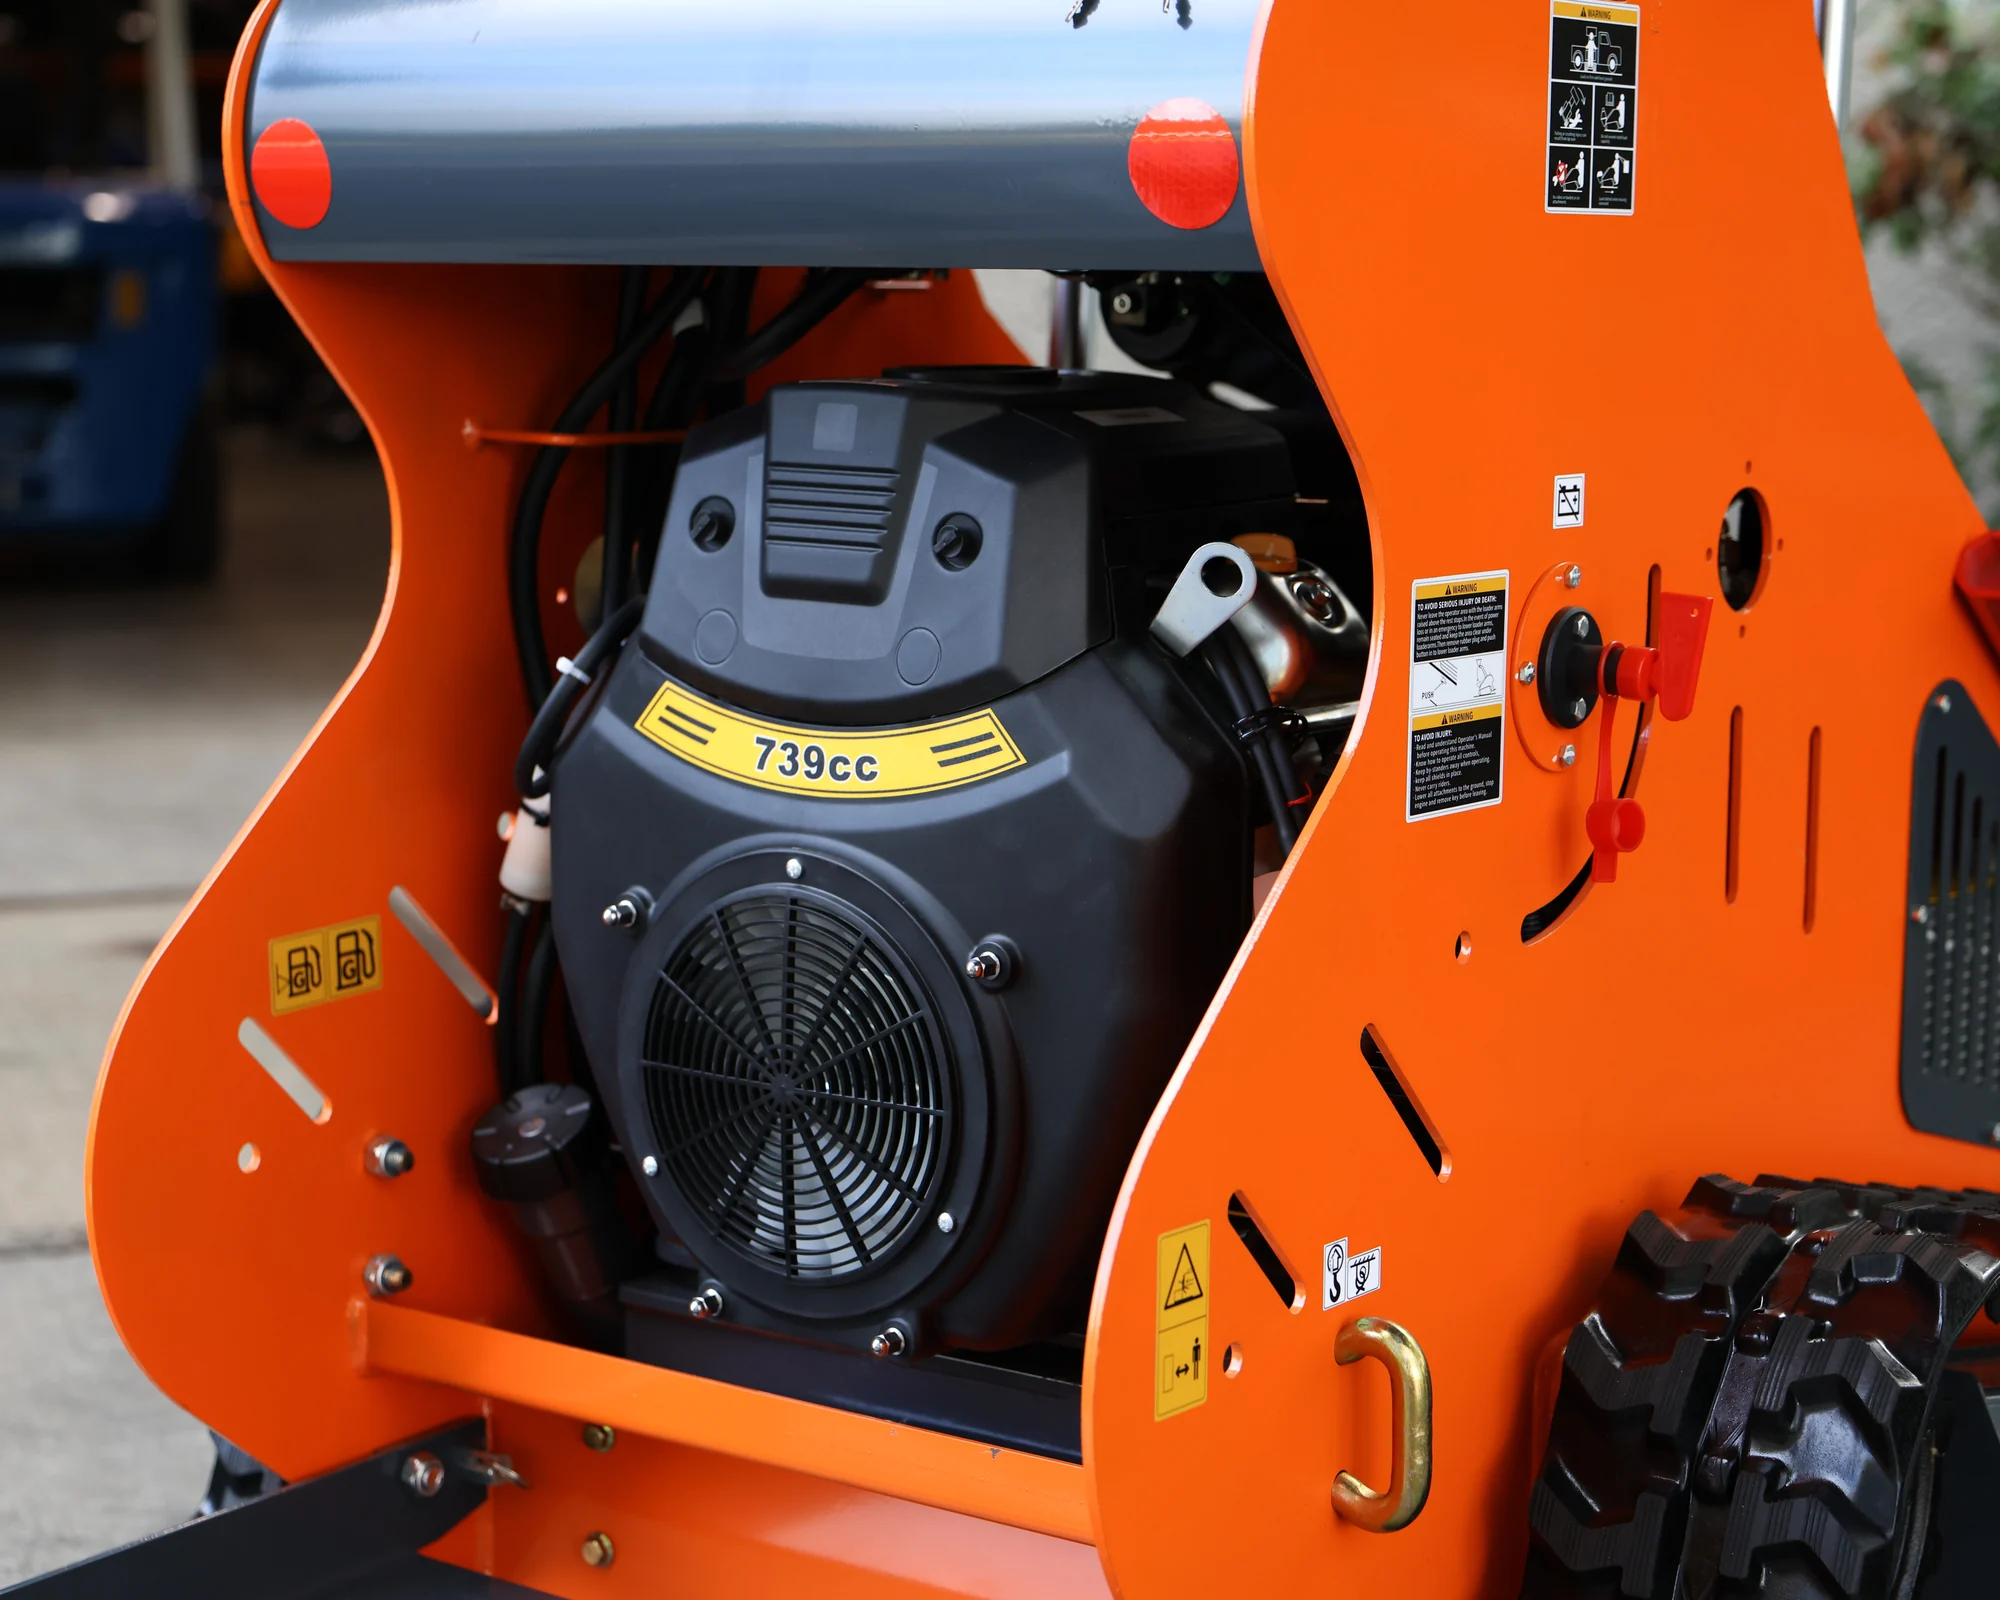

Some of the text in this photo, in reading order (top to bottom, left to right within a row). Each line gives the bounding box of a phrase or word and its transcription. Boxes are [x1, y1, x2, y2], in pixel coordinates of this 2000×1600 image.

[1588, 9, 1611, 20] WARNING
[1453, 583, 1477, 594] WARNING
[1425, 602, 1438, 610] AVOID
[1439, 600, 1457, 608] SERIOUS
[1458, 597, 1474, 606] INJURY
[1482, 594, 1497, 603] DEATH:
[1422, 691, 1434, 699] PUSH
[1449, 712, 1473, 723] WARNING
[1421, 732, 1434, 741] AVOID
[1435, 729, 1452, 739] INJURY:
[1435, 738, 1457, 747] understand
[1458, 734, 1477, 744] Operator's
[1479, 731, 1492, 739] Manual
[1430, 748, 1449, 757] operating
[755, 736, 879, 782] 739cc
[1442, 754, 1456, 763] operate
[1427, 784, 1437, 792] carry
[1433, 787, 1457, 797] attachments
[1470, 781, 1485, 791] ground,
[1414, 801, 1428, 810] engine
[1472, 789, 1487, 798] leaving.
